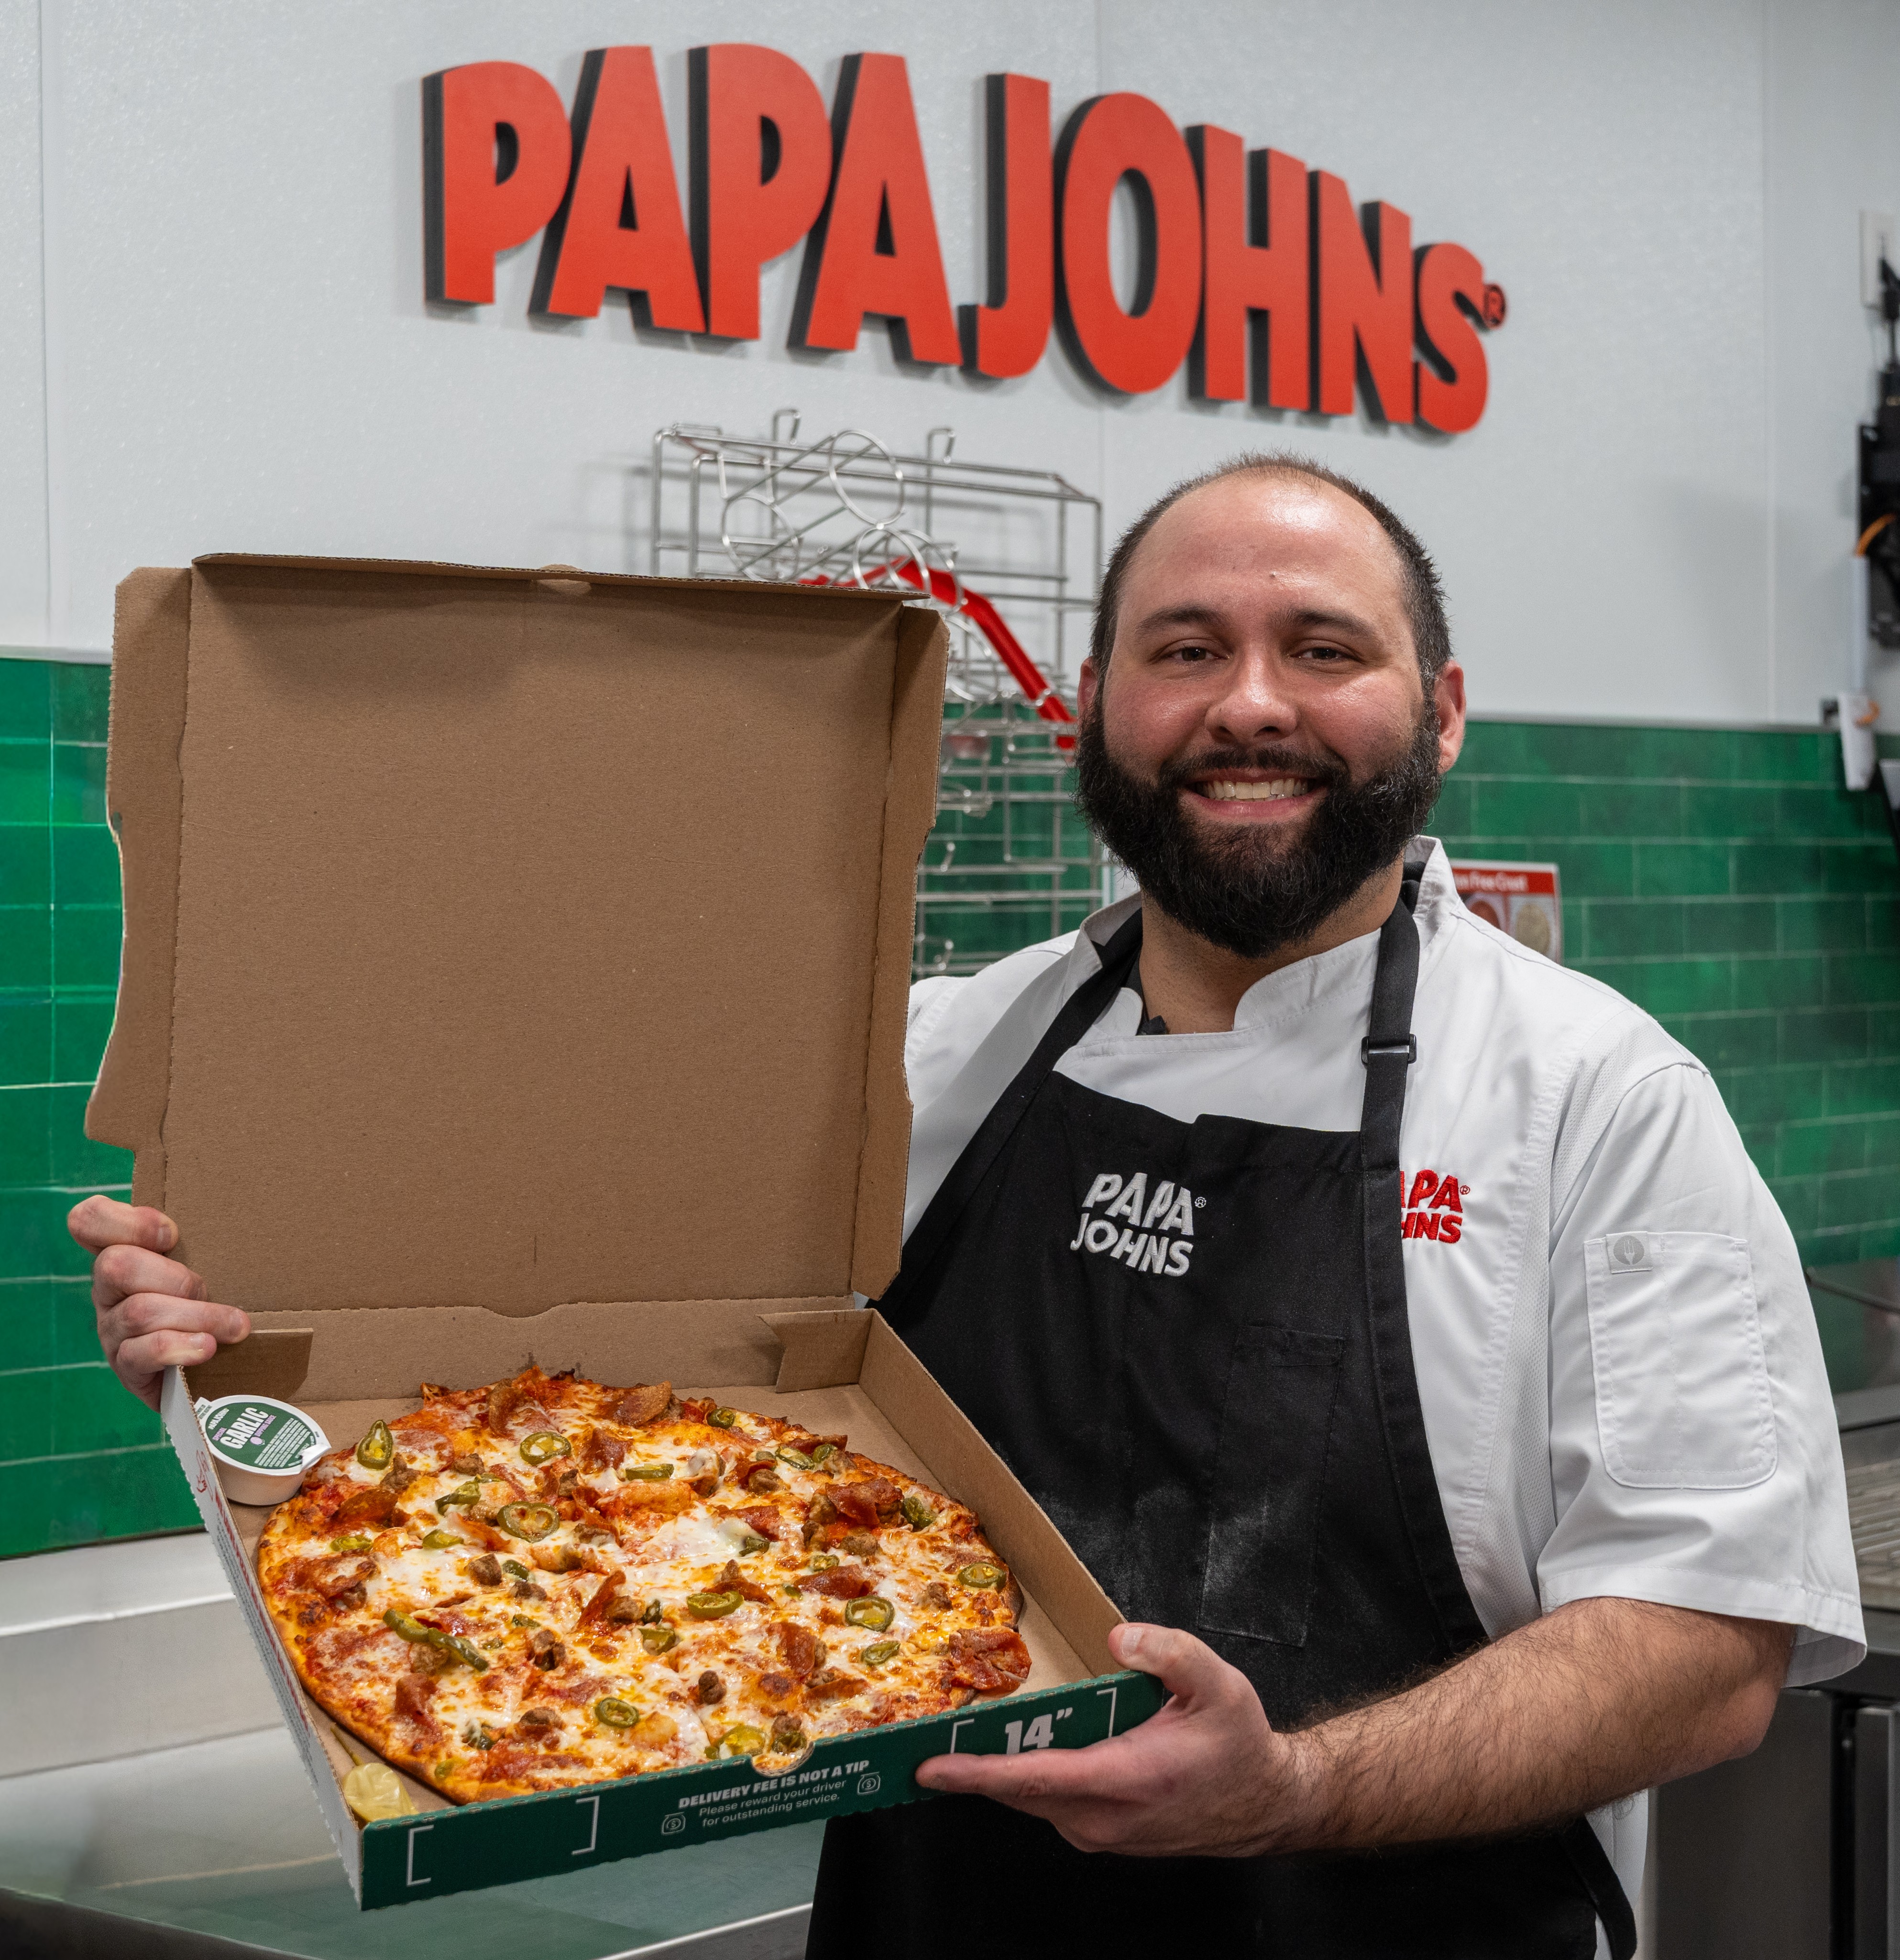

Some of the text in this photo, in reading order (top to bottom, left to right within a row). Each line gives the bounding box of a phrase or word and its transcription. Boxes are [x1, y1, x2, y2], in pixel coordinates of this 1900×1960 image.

[1070, 1213, 1194, 1277] JOHNS
[212, 1427, 227, 1441] SPECIAL
[220, 1407, 269, 1449] GARLIC
[254, 1414, 277, 1437] DIPPING SAUCE
[679, 1760, 869, 1809] DELIVERY FEE IS NOT A TIP
[699, 1779, 847, 1817] Please reward your driver
[702, 1792, 840, 1828] for outstanding service.
